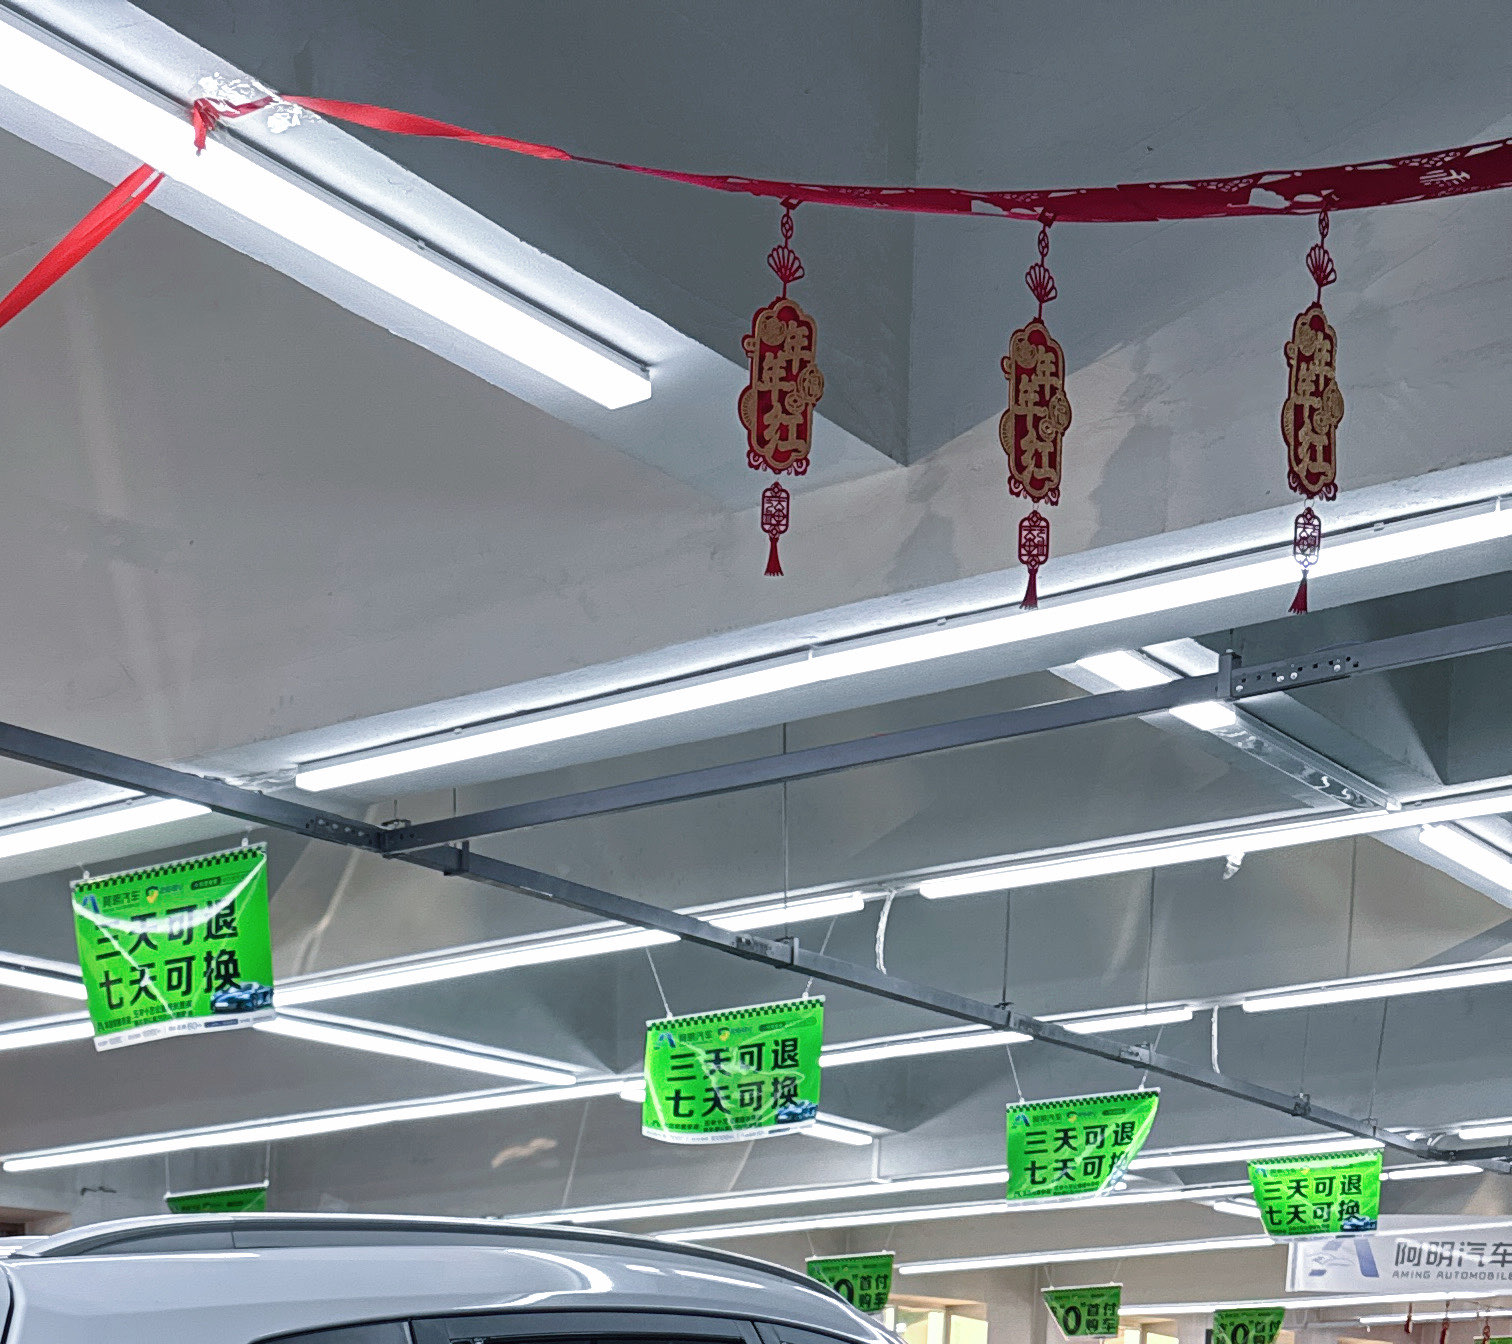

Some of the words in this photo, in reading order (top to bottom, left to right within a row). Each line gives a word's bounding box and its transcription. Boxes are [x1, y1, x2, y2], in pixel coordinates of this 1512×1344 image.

[99, 949, 240, 1010] 七天可换
[667, 1038, 799, 1082] 三天可退
[665, 1076, 799, 1118] 七天可换
[1024, 1121, 1135, 1154] 三天可退
[1262, 1174, 1363, 1201] 三天可退
[1265, 1199, 1361, 1227] 七天可换
[1392, 1270, 1431, 1280] AMING
